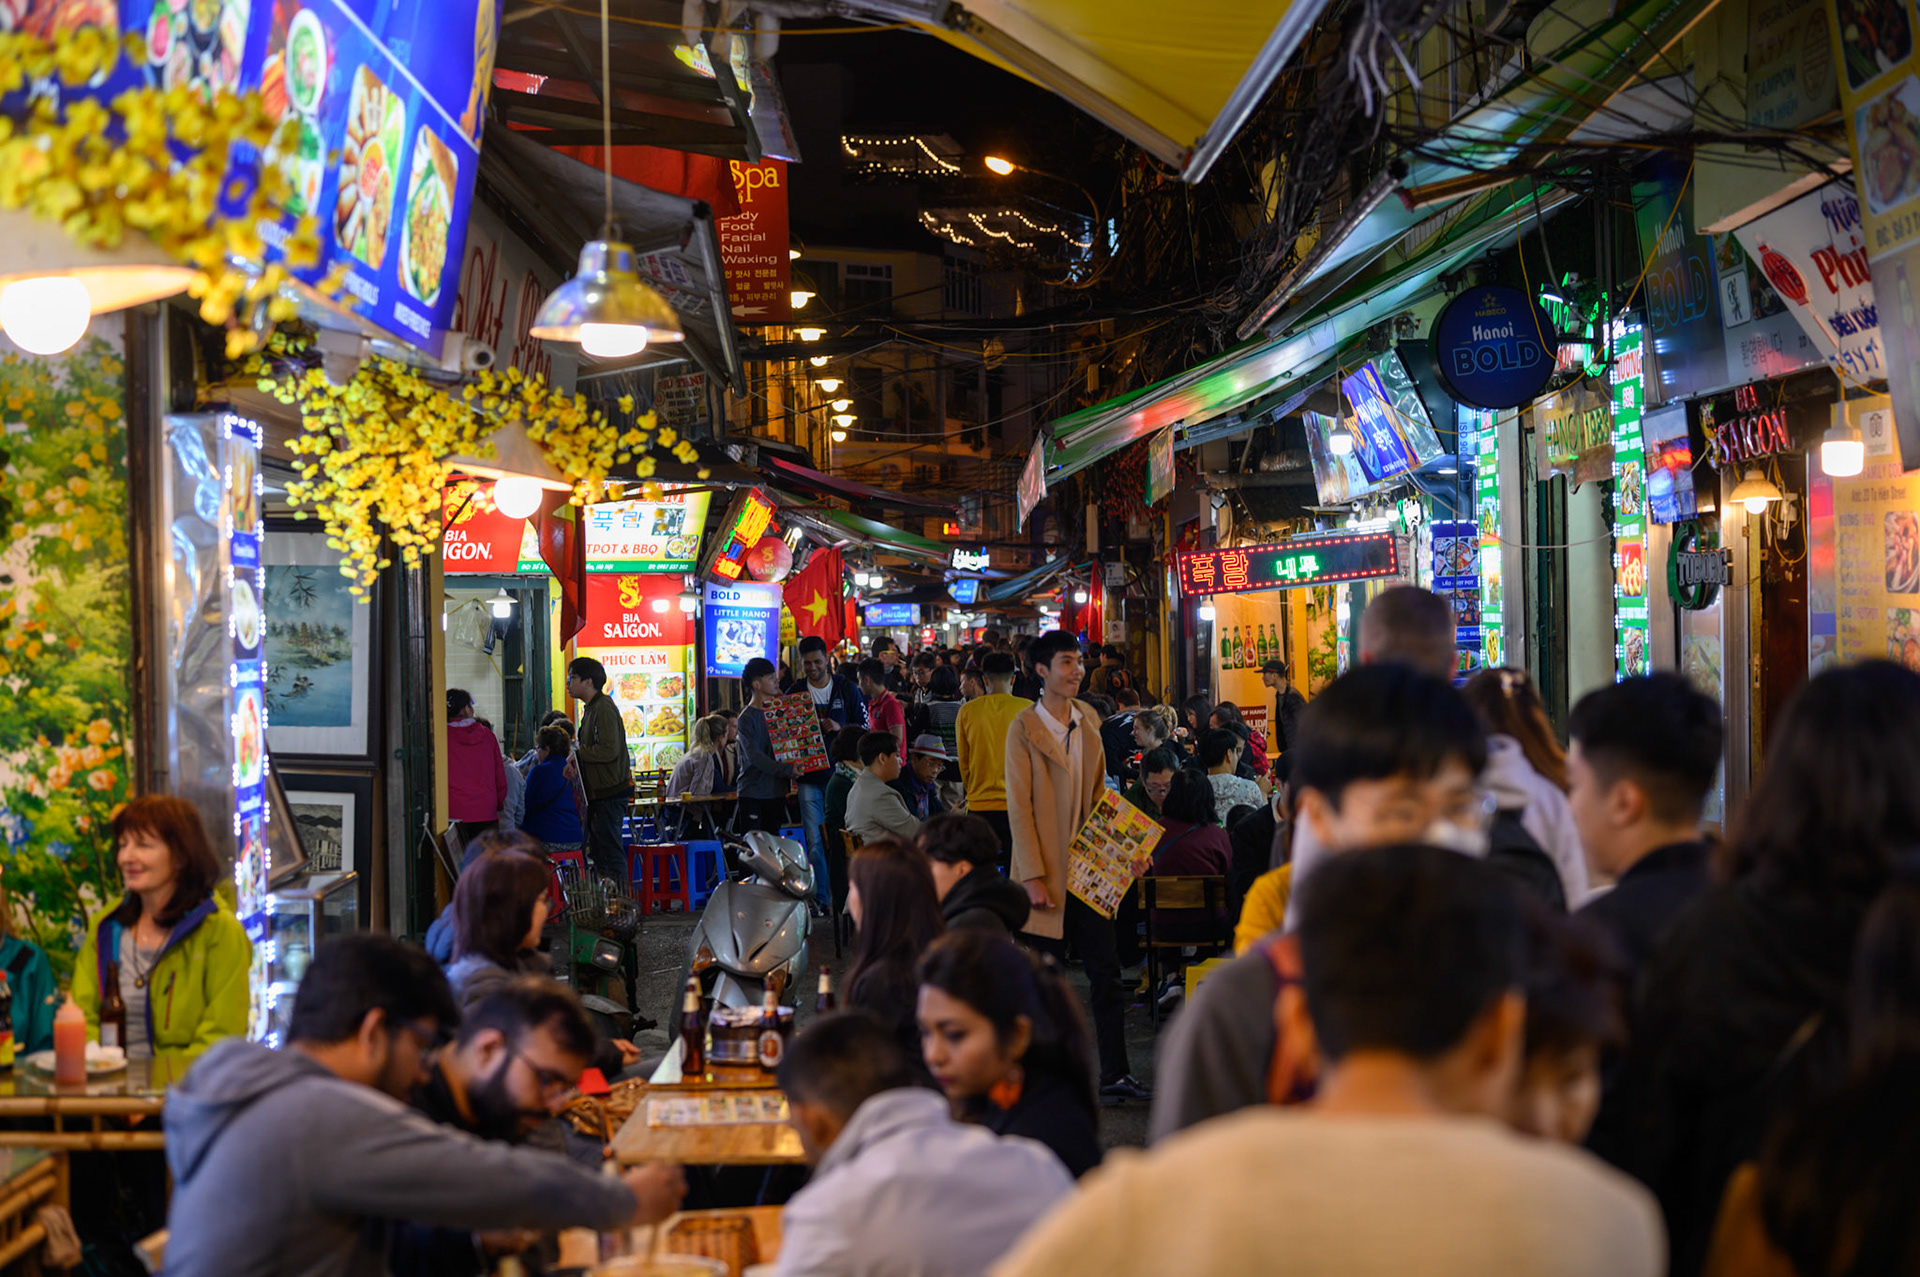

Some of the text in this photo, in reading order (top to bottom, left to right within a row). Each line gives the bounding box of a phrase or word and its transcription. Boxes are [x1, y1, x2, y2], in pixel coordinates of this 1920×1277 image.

[721, 222, 755, 231] Foot
[721, 232, 766, 242] Facial
[1655, 213, 1685, 257] Hanoi
[721, 244, 751, 253] Nail
[721, 254, 778, 265] Waxing
[1648, 256, 1709, 333] BOLD
[1474, 307, 1507, 317] HABECO
[1472, 321, 1514, 341] Hanoi
[1453, 340, 1541, 376] BOLD
[1735, 383, 1761, 411] BIA
[1545, 412, 1582, 459] HANOI
[1583, 407, 1610, 449] 1983
[1718, 406, 1791, 465] SAIGON
[444, 530, 467, 542] BIA
[443, 543, 489, 560] IGON
[586, 543, 658, 556] TPOT & BBQ
[1676, 548, 1729, 587] TUBORG
[711, 590, 741, 601] BOLD
[622, 613, 640, 623] BIA
[714, 609, 770, 618] LITTLE HANOI
[603, 623, 660, 638] SAIGON
[602, 652, 667, 666] PHÚC LÂM
